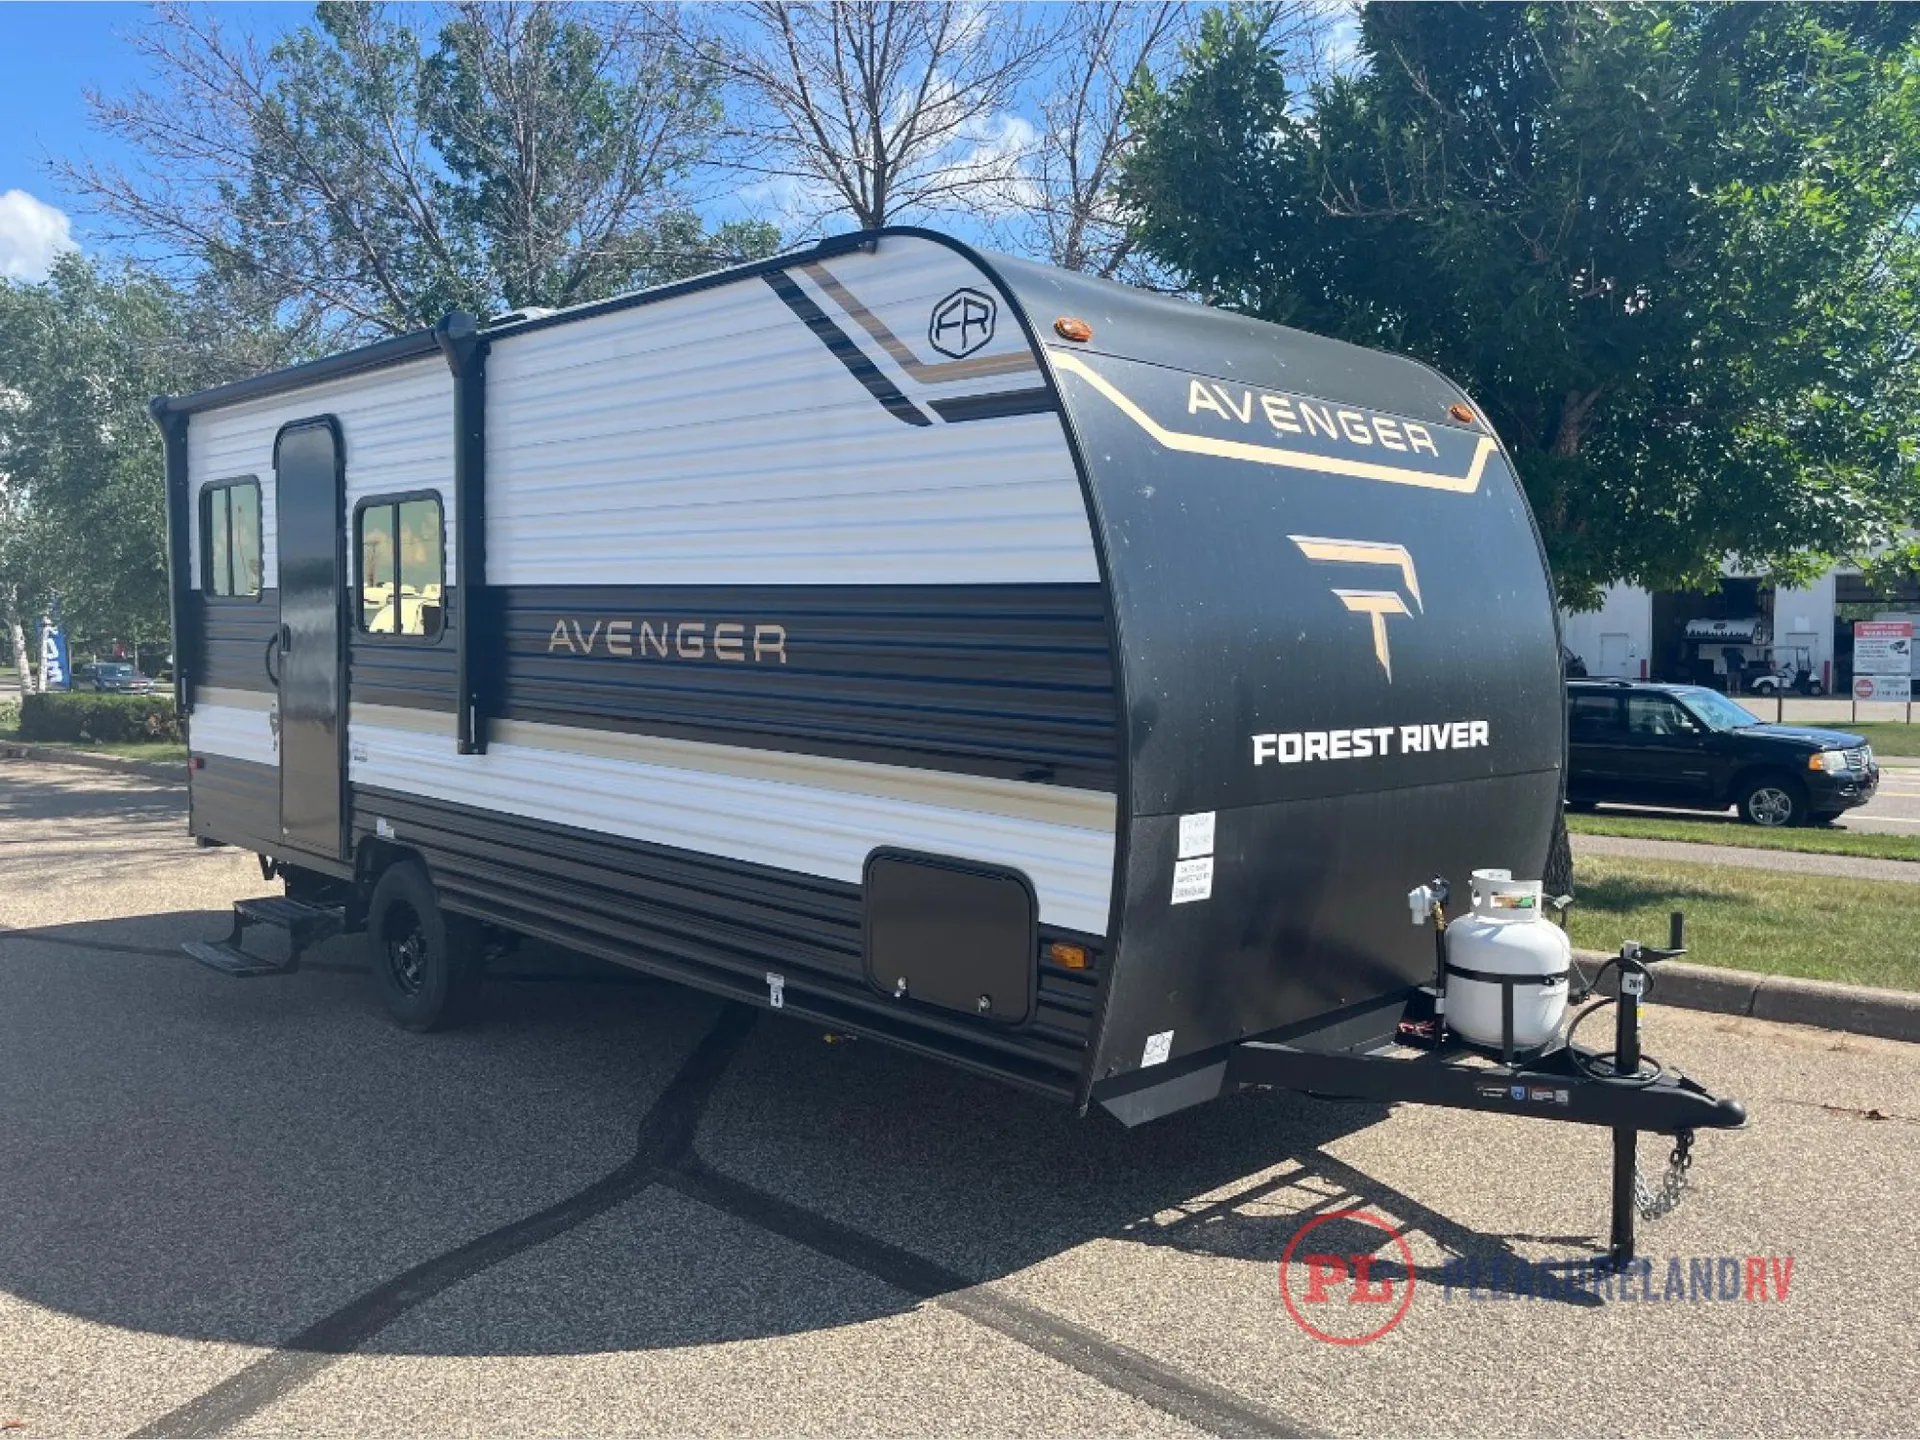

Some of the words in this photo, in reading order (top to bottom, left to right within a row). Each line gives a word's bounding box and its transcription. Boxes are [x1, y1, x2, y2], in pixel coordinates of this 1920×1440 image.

[1188, 379, 1439, 458] AVENGER
[548, 619, 787, 664] AVENGER
[1251, 726, 1394, 766] FOREST
[1400, 719, 1490, 754] RIVER
